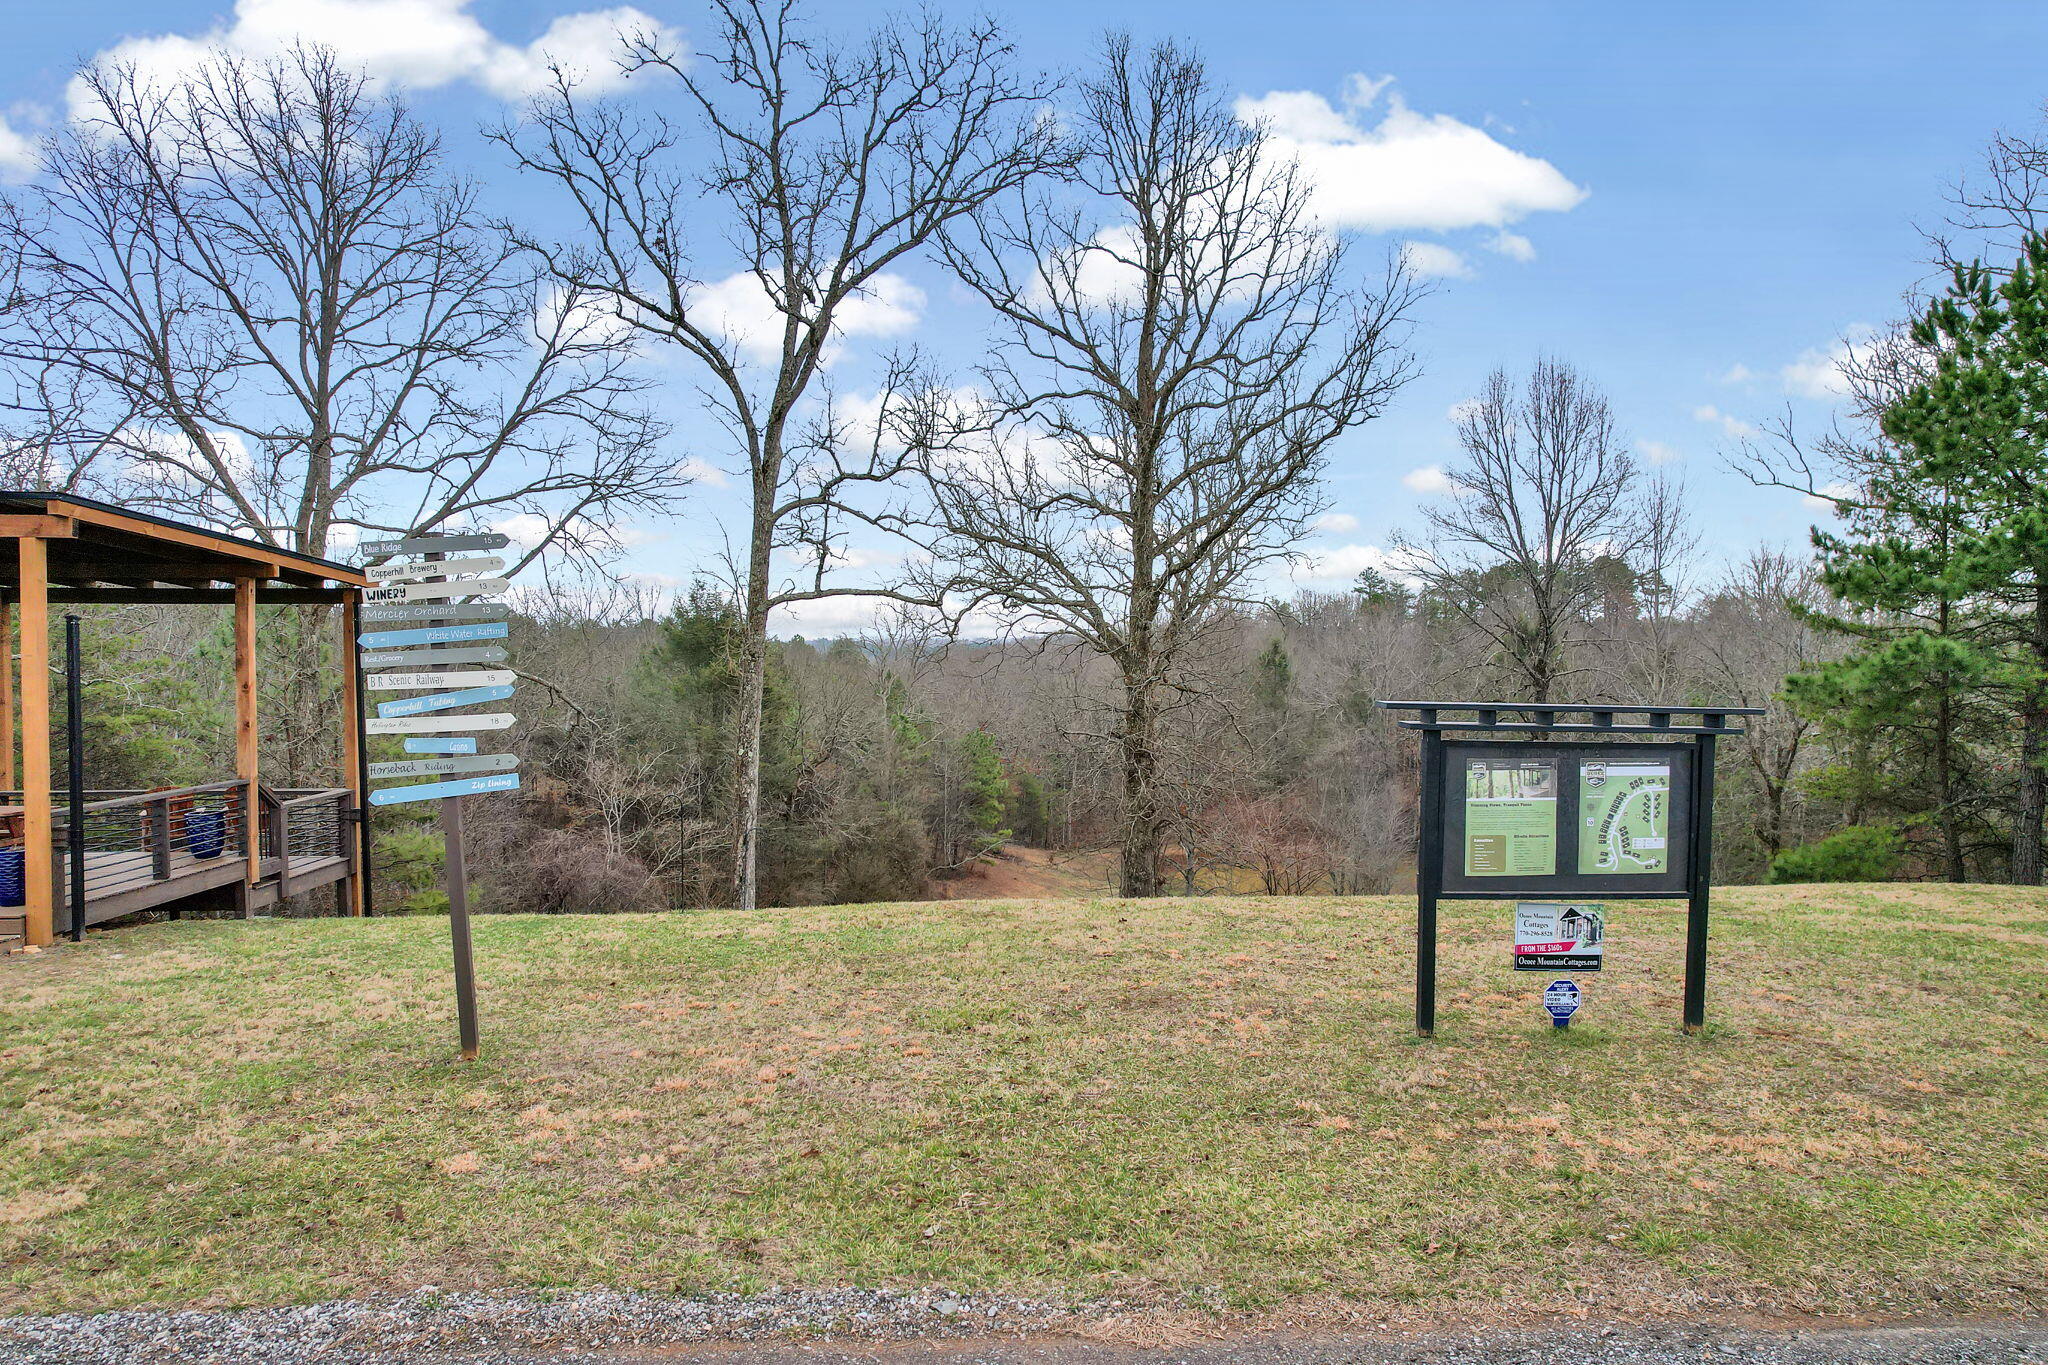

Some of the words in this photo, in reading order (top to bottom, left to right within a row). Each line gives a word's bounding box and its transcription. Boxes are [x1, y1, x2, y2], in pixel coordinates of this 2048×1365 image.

[484, 536, 492, 544] 15
[364, 544, 380, 554] Blue
[382, 542, 402, 554] Ridge
[371, 566, 404, 578] Copperhill
[410, 564, 438, 574] Brewery
[366, 588, 406, 601] WINERY
[364, 608, 409, 619] Mercier
[414, 605, 456, 616] Orchard
[482, 606, 491, 614] 13
[426, 632, 449, 640] White
[451, 629, 473, 638] Water
[370, 676, 376, 688] B
[378, 676, 384, 688] R
[388, 674, 411, 686] Scenic
[416, 674, 444, 687] Railway
[487, 674, 496, 682] 15
[383, 702, 424, 715] Copperhill
[428, 696, 456, 708] Tubing
[495, 758, 500, 766] 2
[370, 762, 416, 776] Horseback
[424, 763, 456, 772] Riding
[472, 780, 486, 790] Zip
[1524, 920, 1549, 929] Cottages
[1536, 944, 1547, 952] THE
[1548, 944, 1563, 952] $160s
[1518, 956, 1536, 966] Ocoee
[1536, 957, 1598, 967] MountainCottages.com
